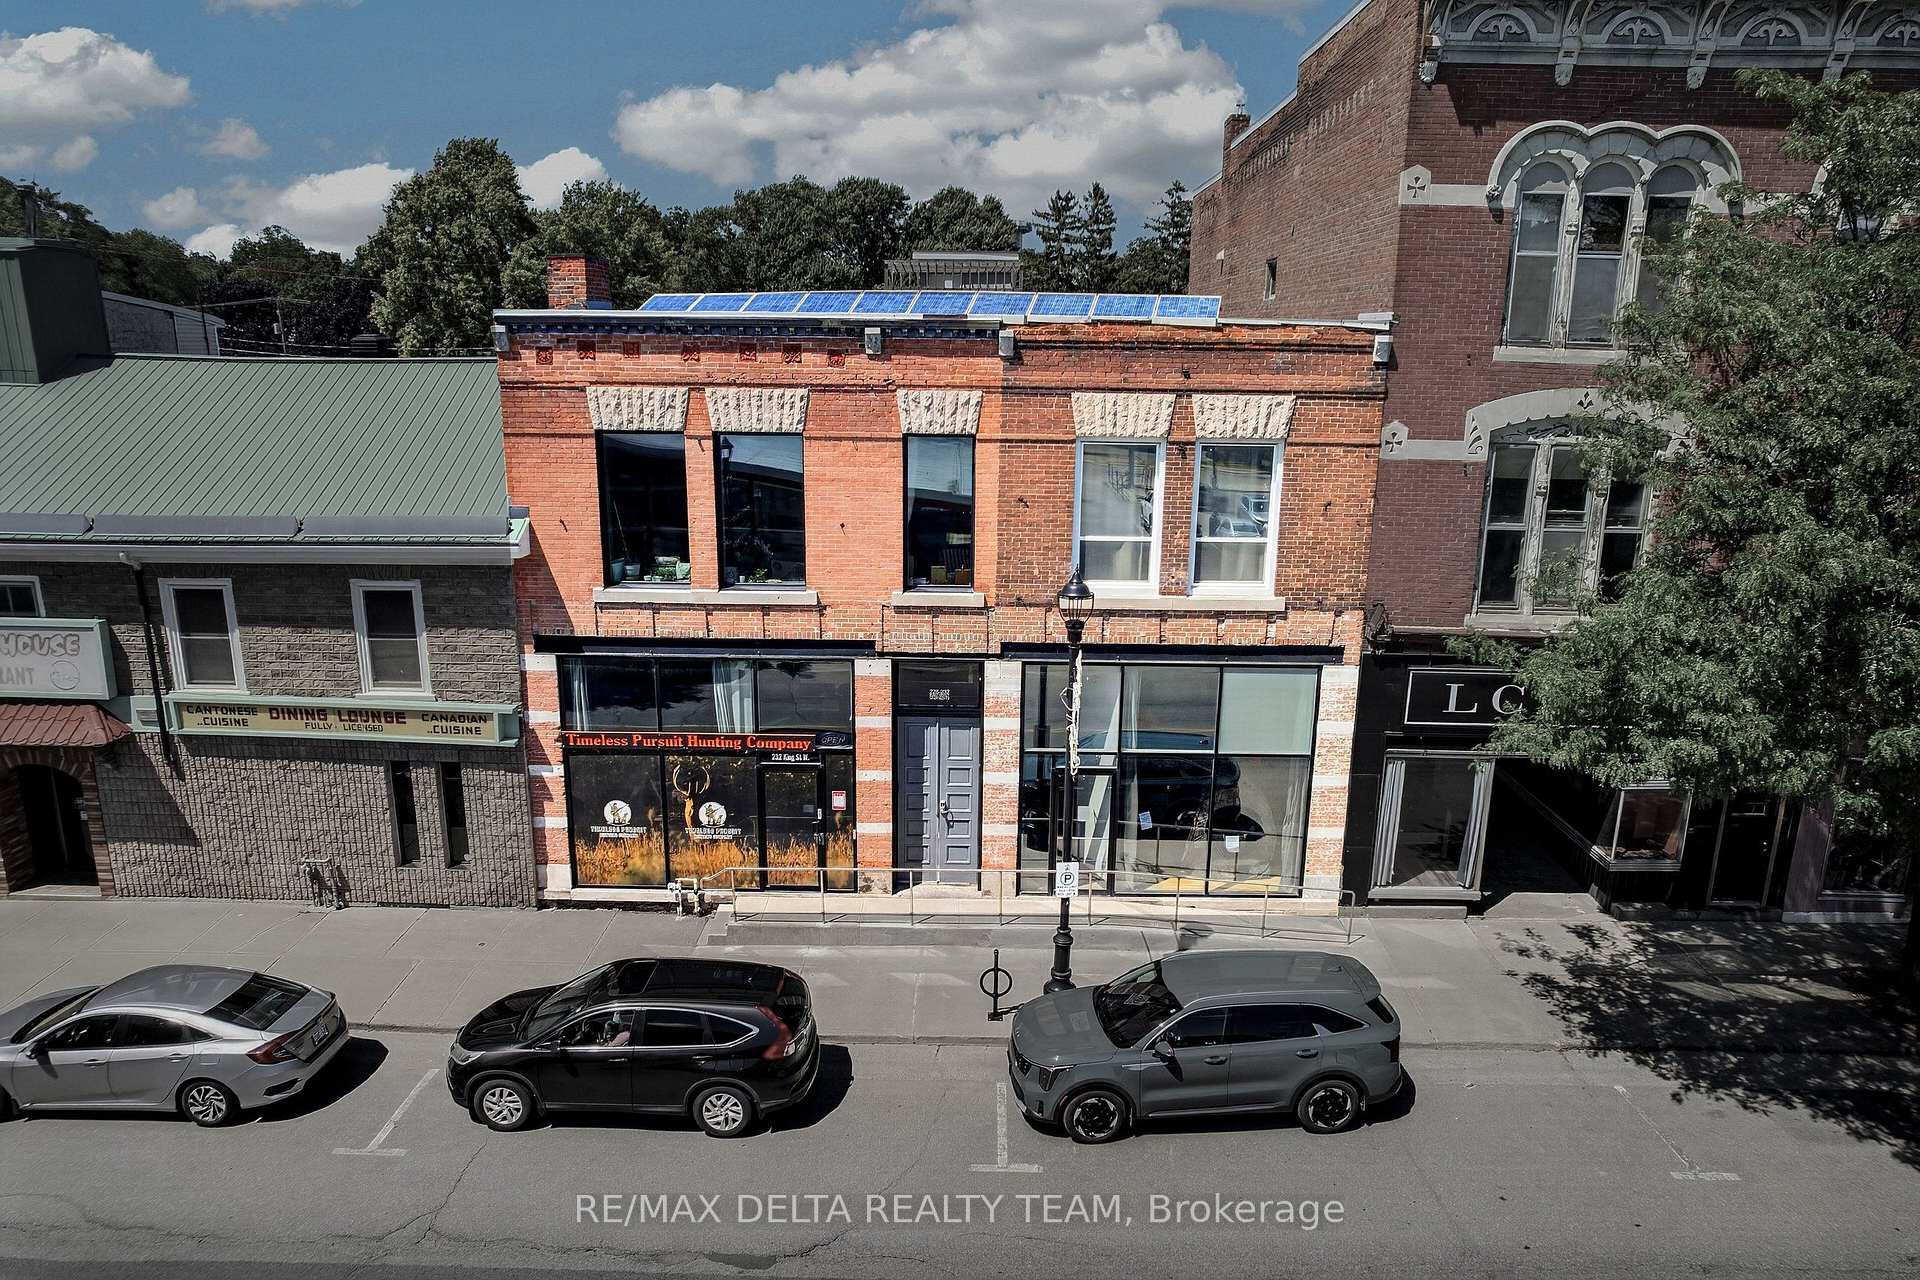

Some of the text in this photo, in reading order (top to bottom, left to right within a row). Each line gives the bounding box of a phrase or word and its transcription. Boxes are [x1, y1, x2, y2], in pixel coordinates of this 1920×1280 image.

[186, 704, 258, 716] CANTONESE
[269, 707, 328, 721] DINING
[337, 710, 407, 724] LOUNGE
[421, 713, 488, 724] CANADIAN
[304, 721, 333, 730] FULLY
[566, 733, 812, 752] Timeless Pursuit Hunting Company
[821, 736, 846, 745] OPEN
